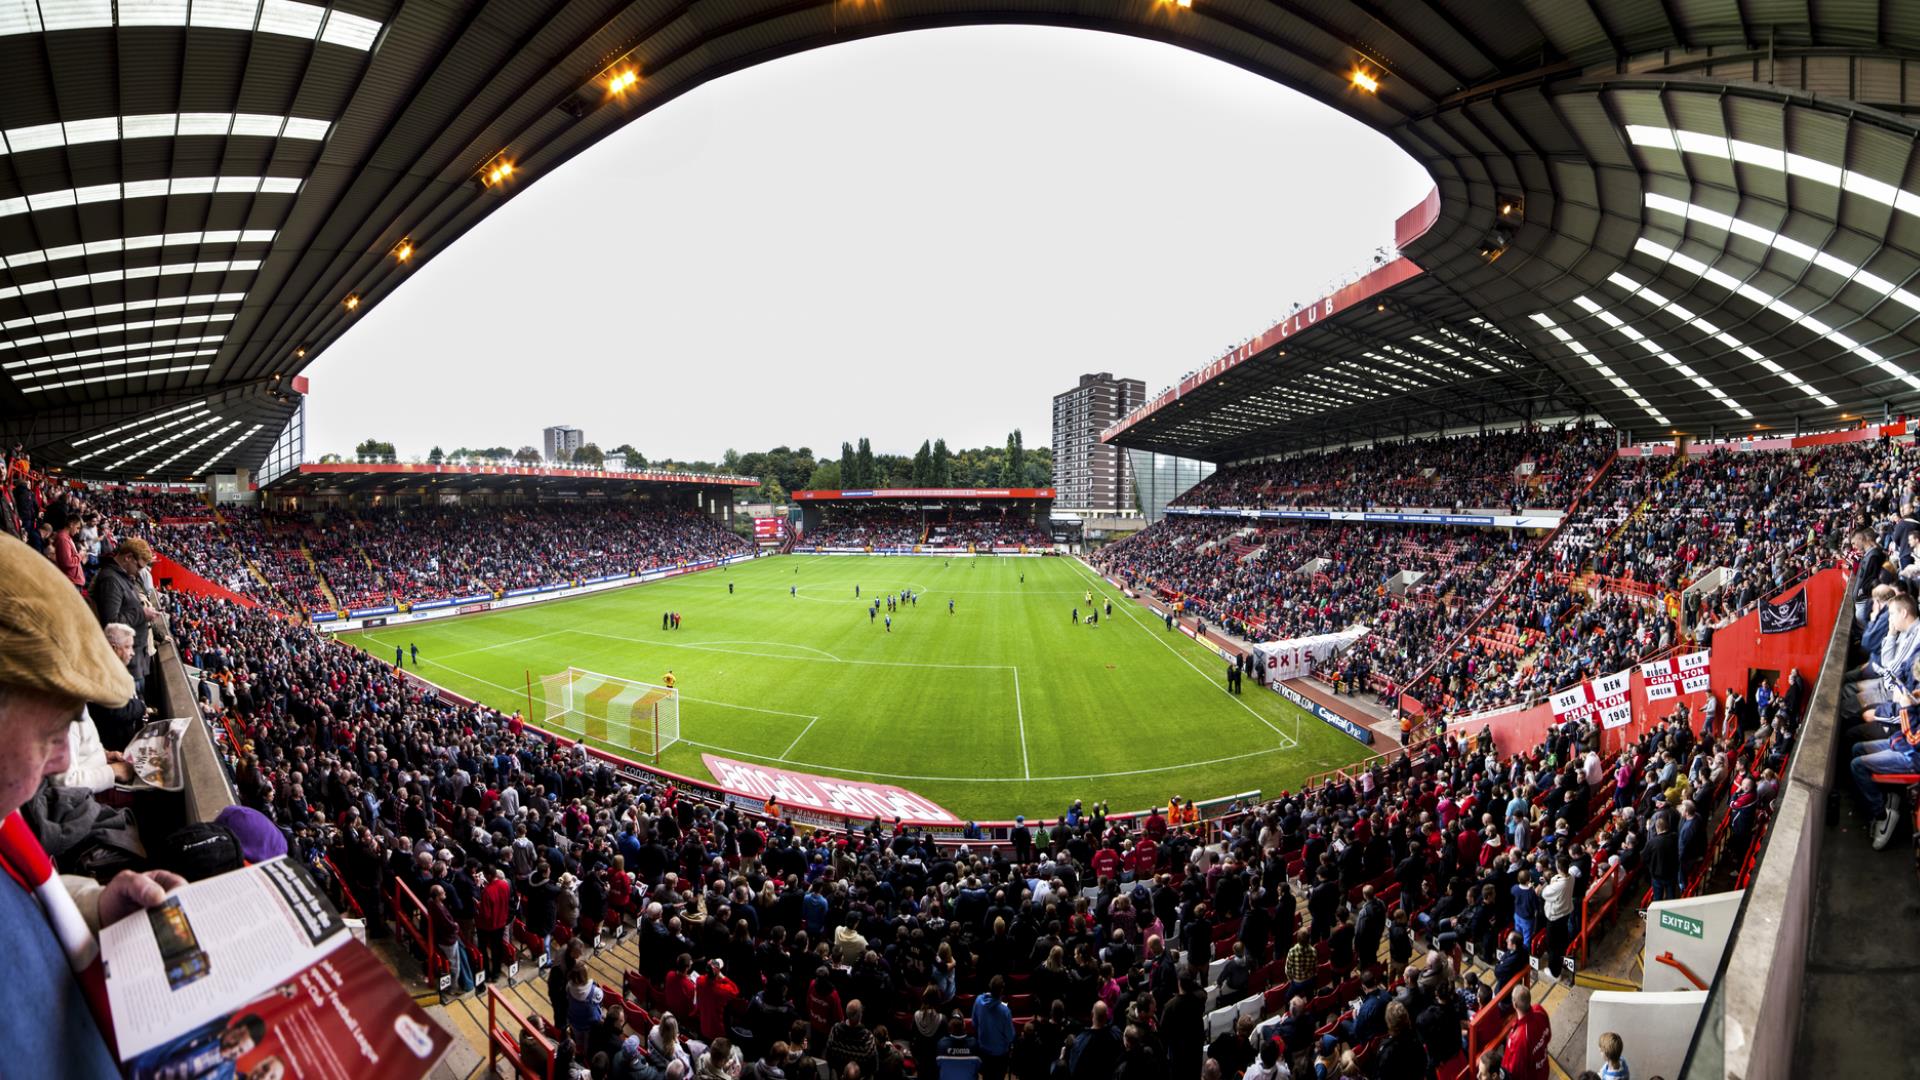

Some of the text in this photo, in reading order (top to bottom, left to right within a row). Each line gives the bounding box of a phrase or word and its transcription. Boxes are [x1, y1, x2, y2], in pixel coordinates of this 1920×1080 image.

[1192, 343, 1253, 389] FOOTBALL
[1281, 298, 1334, 337] CLUB
[466, 465, 551, 476] CHARLTON
[1268, 650, 1312, 669] axis
[1650, 667, 1705, 685] CHARLTON
[1603, 678, 1621, 693] BEN
[1651, 686, 1672, 697] COLIN
[1272, 680, 1315, 712] BETVICTOR.COM
[1560, 694, 1577, 708] SEB
[1563, 692, 1627, 722] CHARLTON
[1662, 914, 1684, 929] EXIT
